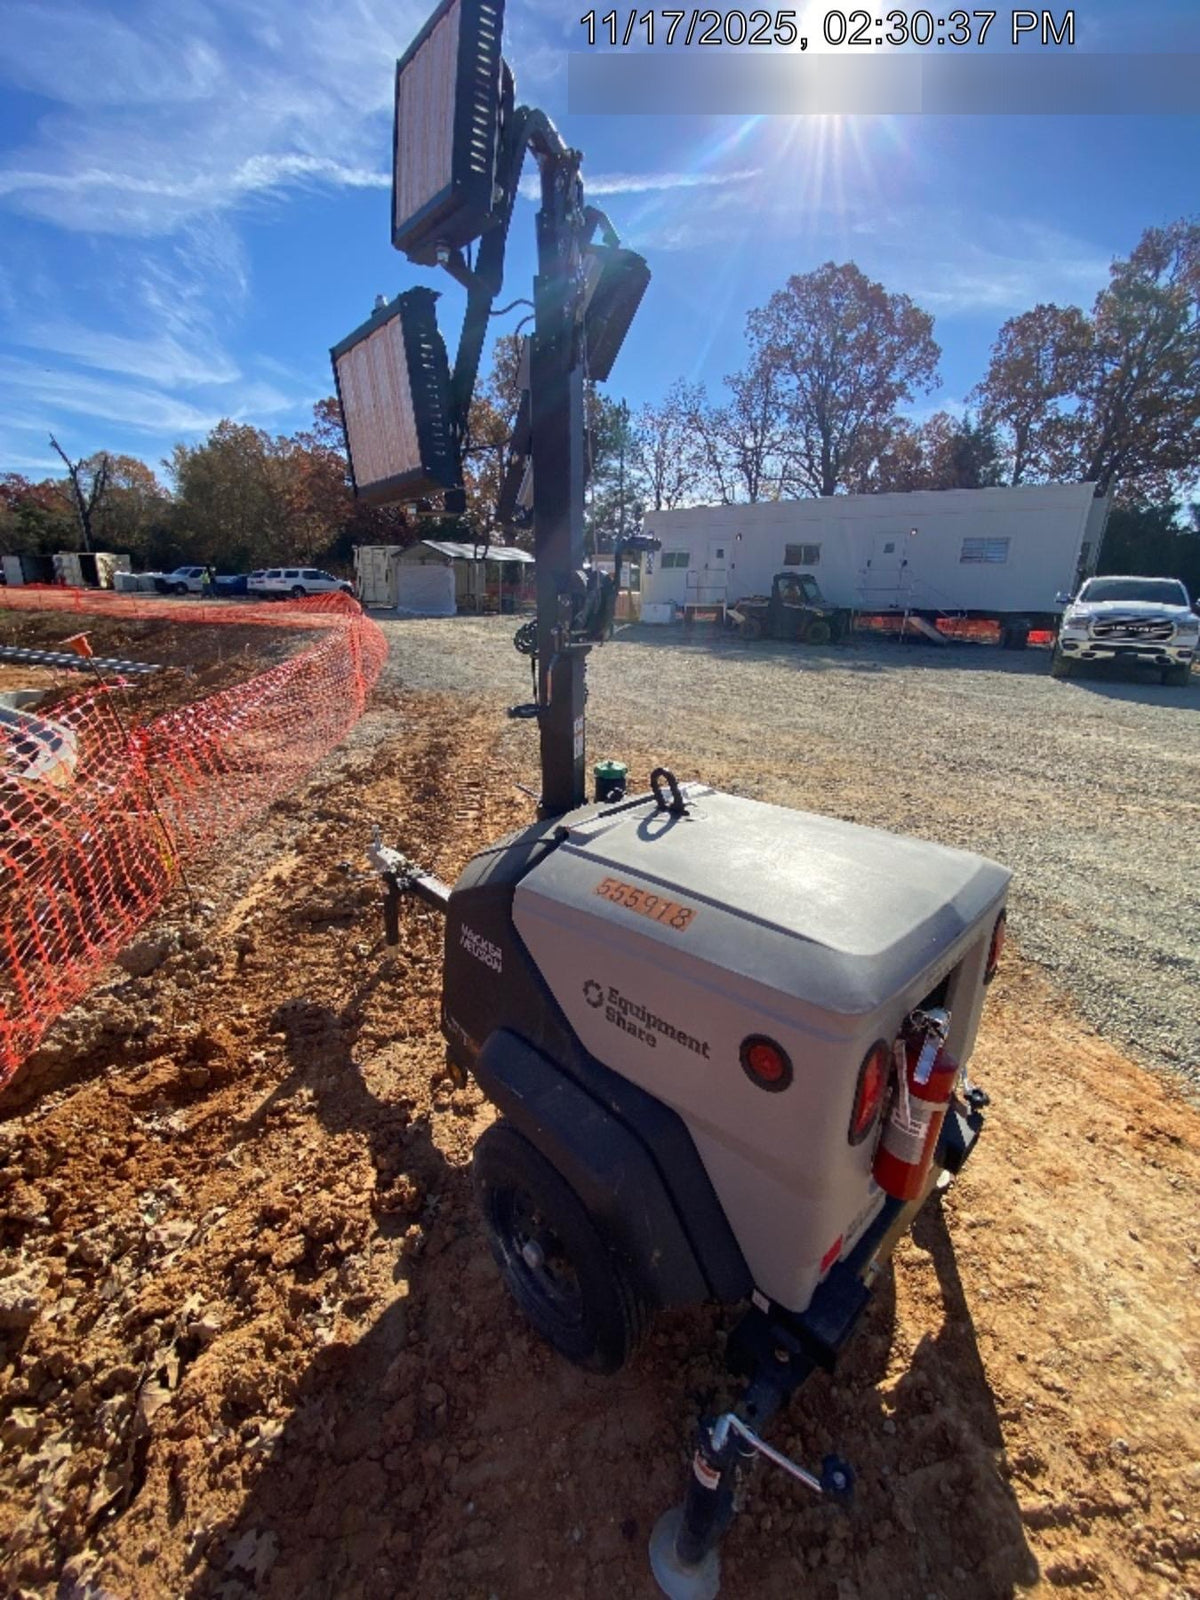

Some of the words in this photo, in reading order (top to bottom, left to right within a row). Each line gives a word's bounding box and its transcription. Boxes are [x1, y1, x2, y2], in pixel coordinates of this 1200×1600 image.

[595, 877, 693, 931] 555918
[605, 1004, 658, 1049] Share
[606, 985, 712, 1060] Equipment
